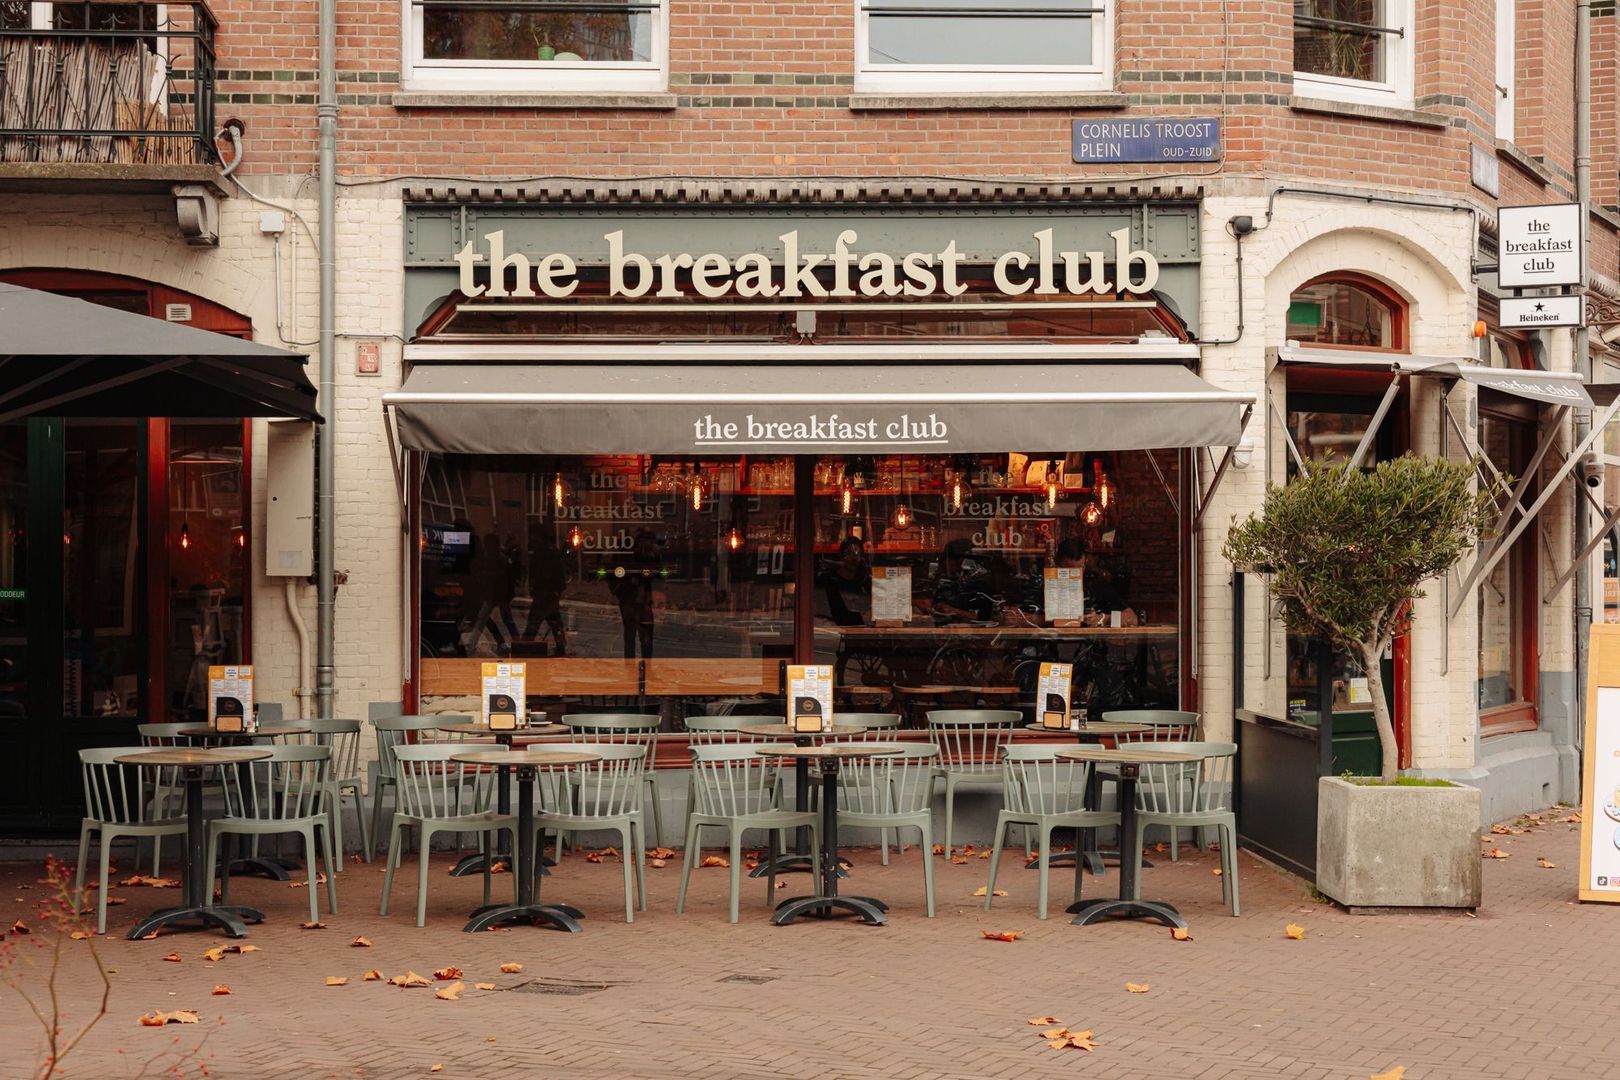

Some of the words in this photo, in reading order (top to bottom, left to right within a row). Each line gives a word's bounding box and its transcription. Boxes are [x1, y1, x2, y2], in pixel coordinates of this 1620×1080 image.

[1081, 123, 1150, 139] CORNELIS
[1155, 123, 1212, 138] TROOST
[1081, 143, 1121, 158] PLEIN
[1163, 147, 1212, 157] OUD-ZUID
[1528, 219, 1551, 232] the
[1506, 238, 1573, 252] breakfast
[454, 229, 580, 298] the
[604, 229, 969, 298] breakfast
[993, 226, 1160, 296] club
[1523, 258, 1555, 271] club
[1519, 314, 1559, 322] Heineken
[1545, 384, 1580, 397] club
[694, 414, 739, 440] the
[746, 414, 879, 440] breakfast
[886, 413, 948, 439] club
[590, 471, 627, 488] the
[979, 465, 1014, 485] the
[554, 496, 665, 520] breakfast
[944, 495, 1051, 517] breakfast
[583, 528, 635, 550] club
[971, 526, 1023, 547] club
